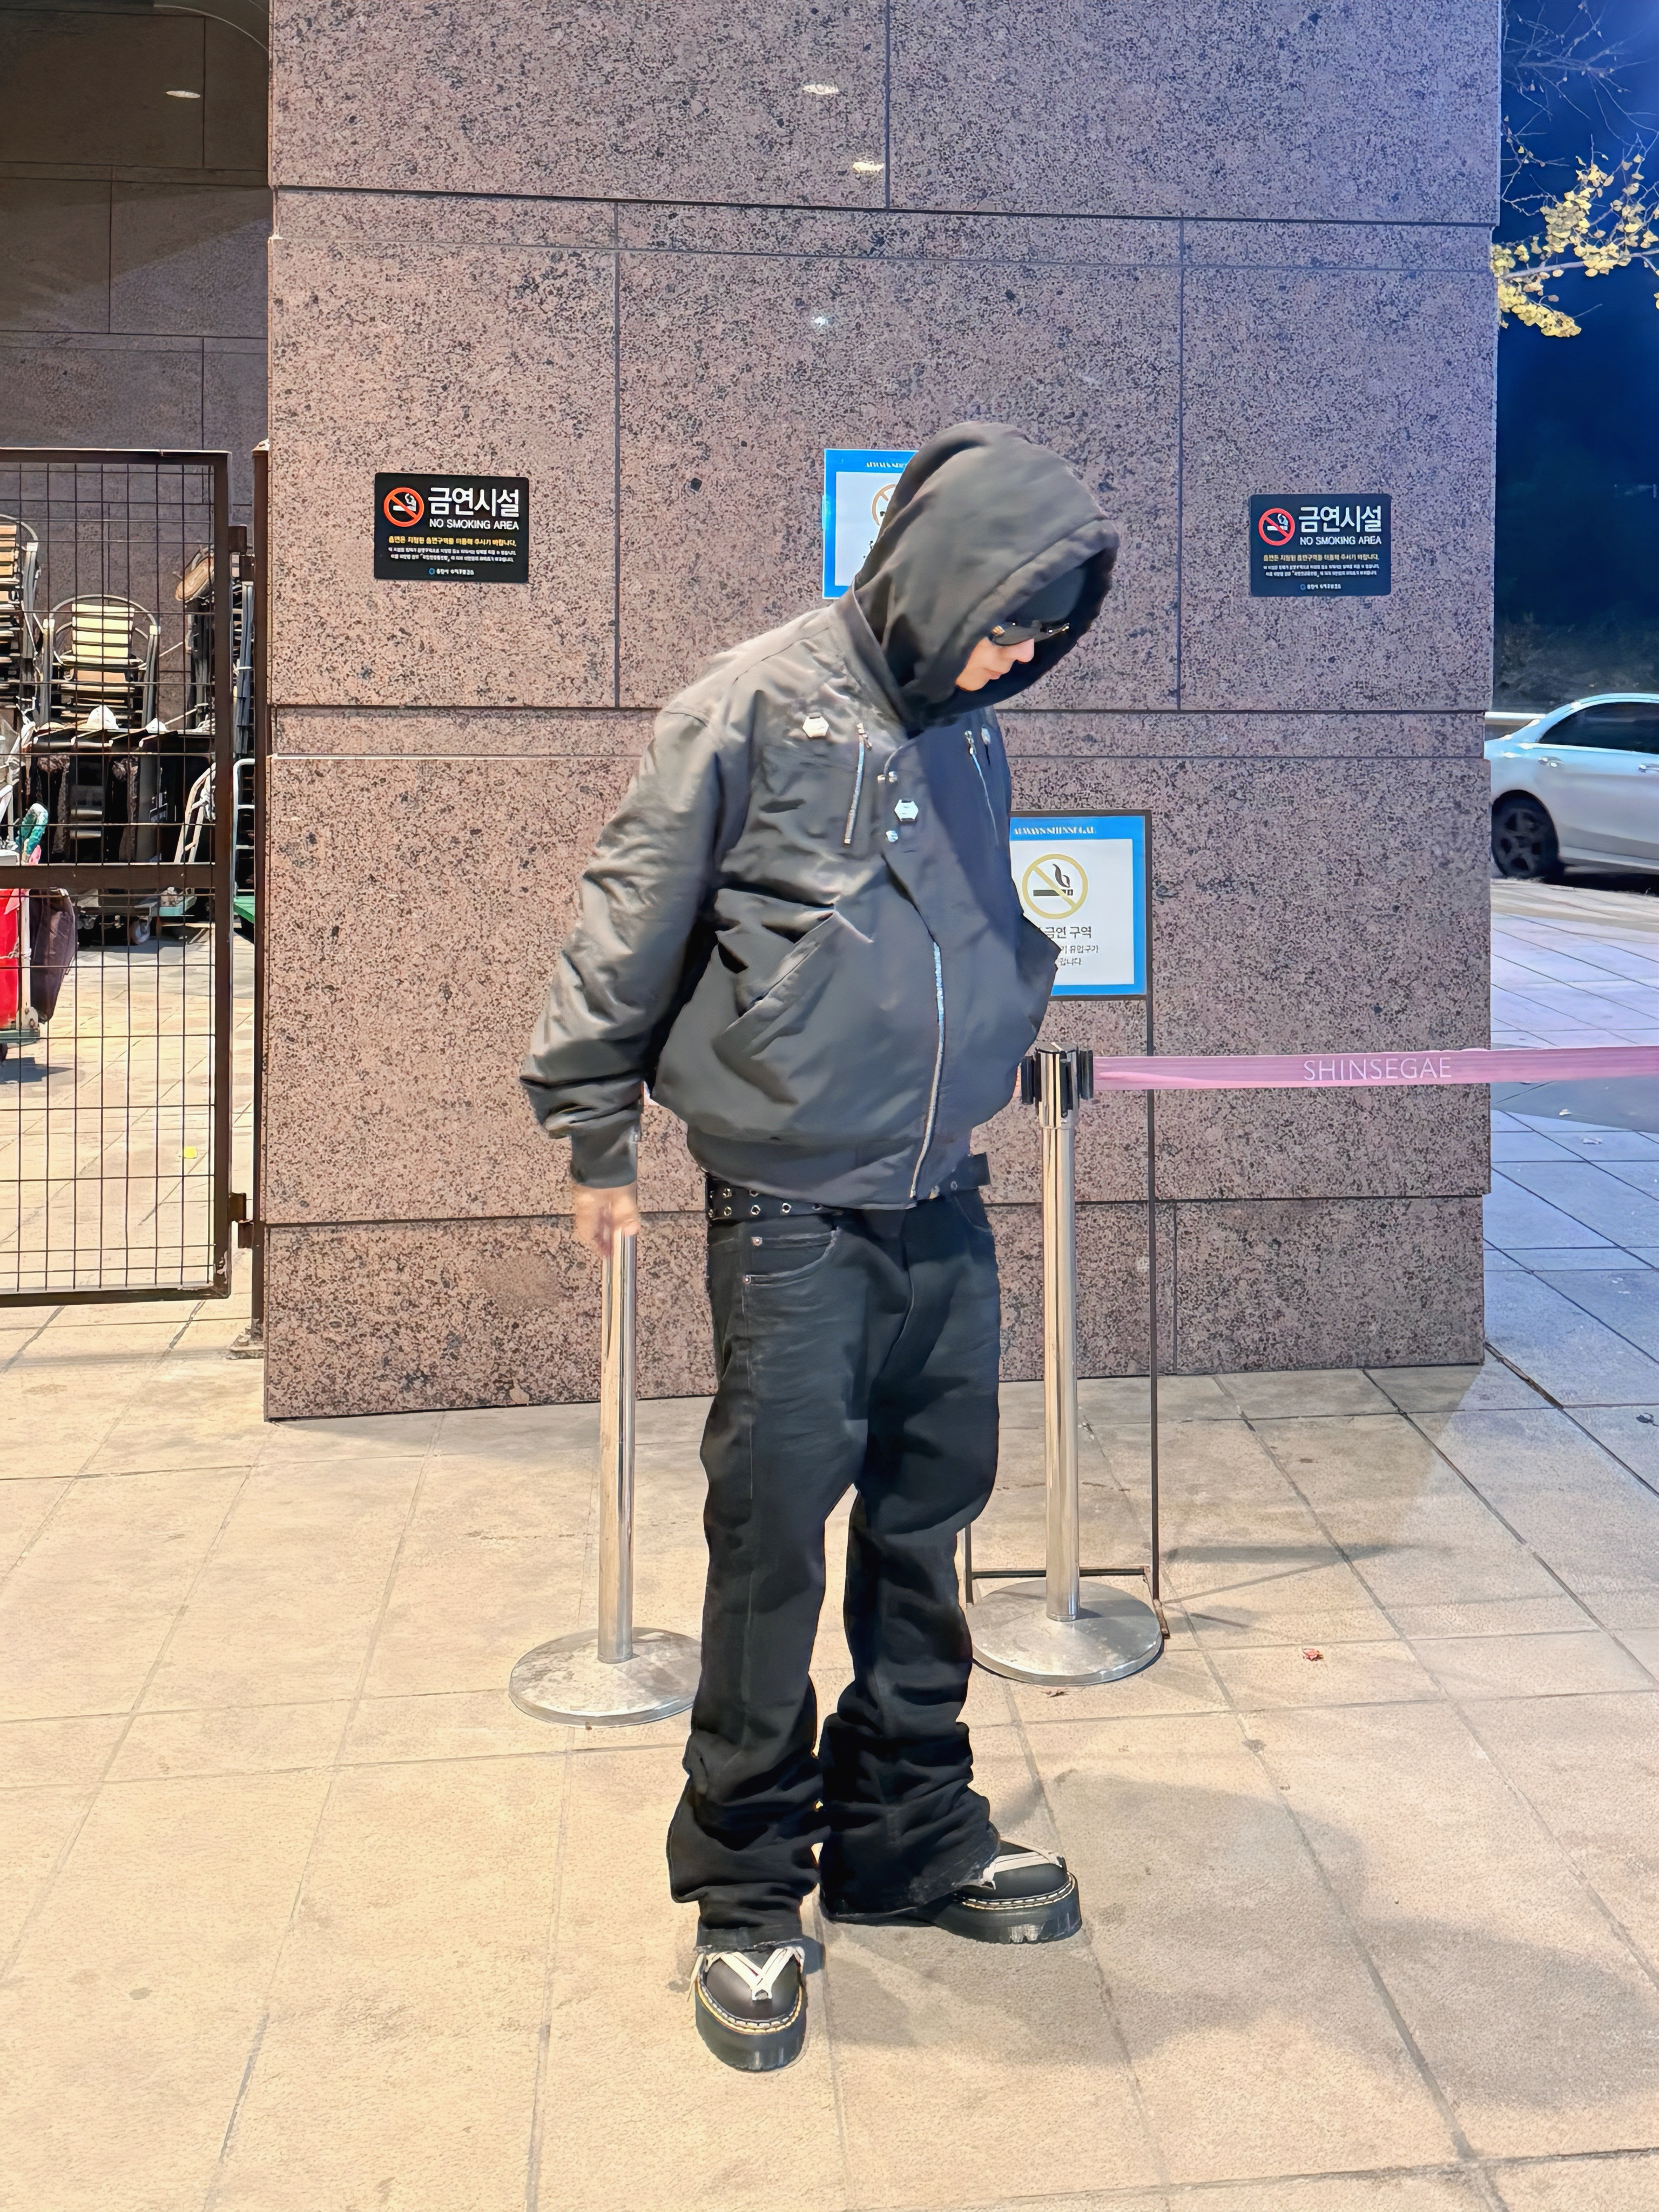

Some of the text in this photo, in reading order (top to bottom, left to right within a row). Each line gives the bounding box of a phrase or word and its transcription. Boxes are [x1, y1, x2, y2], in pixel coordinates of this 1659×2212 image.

[427, 487, 520, 517] 금연시설
[429, 518, 520, 530] NO SMOKING AREA
[1298, 505, 1382, 532] 금연시설
[1300, 536, 1382, 545] NO SMOKING AREA
[1069, 926, 1091, 939] 구역
[1304, 1057, 1452, 1080] SHINSEGAE
